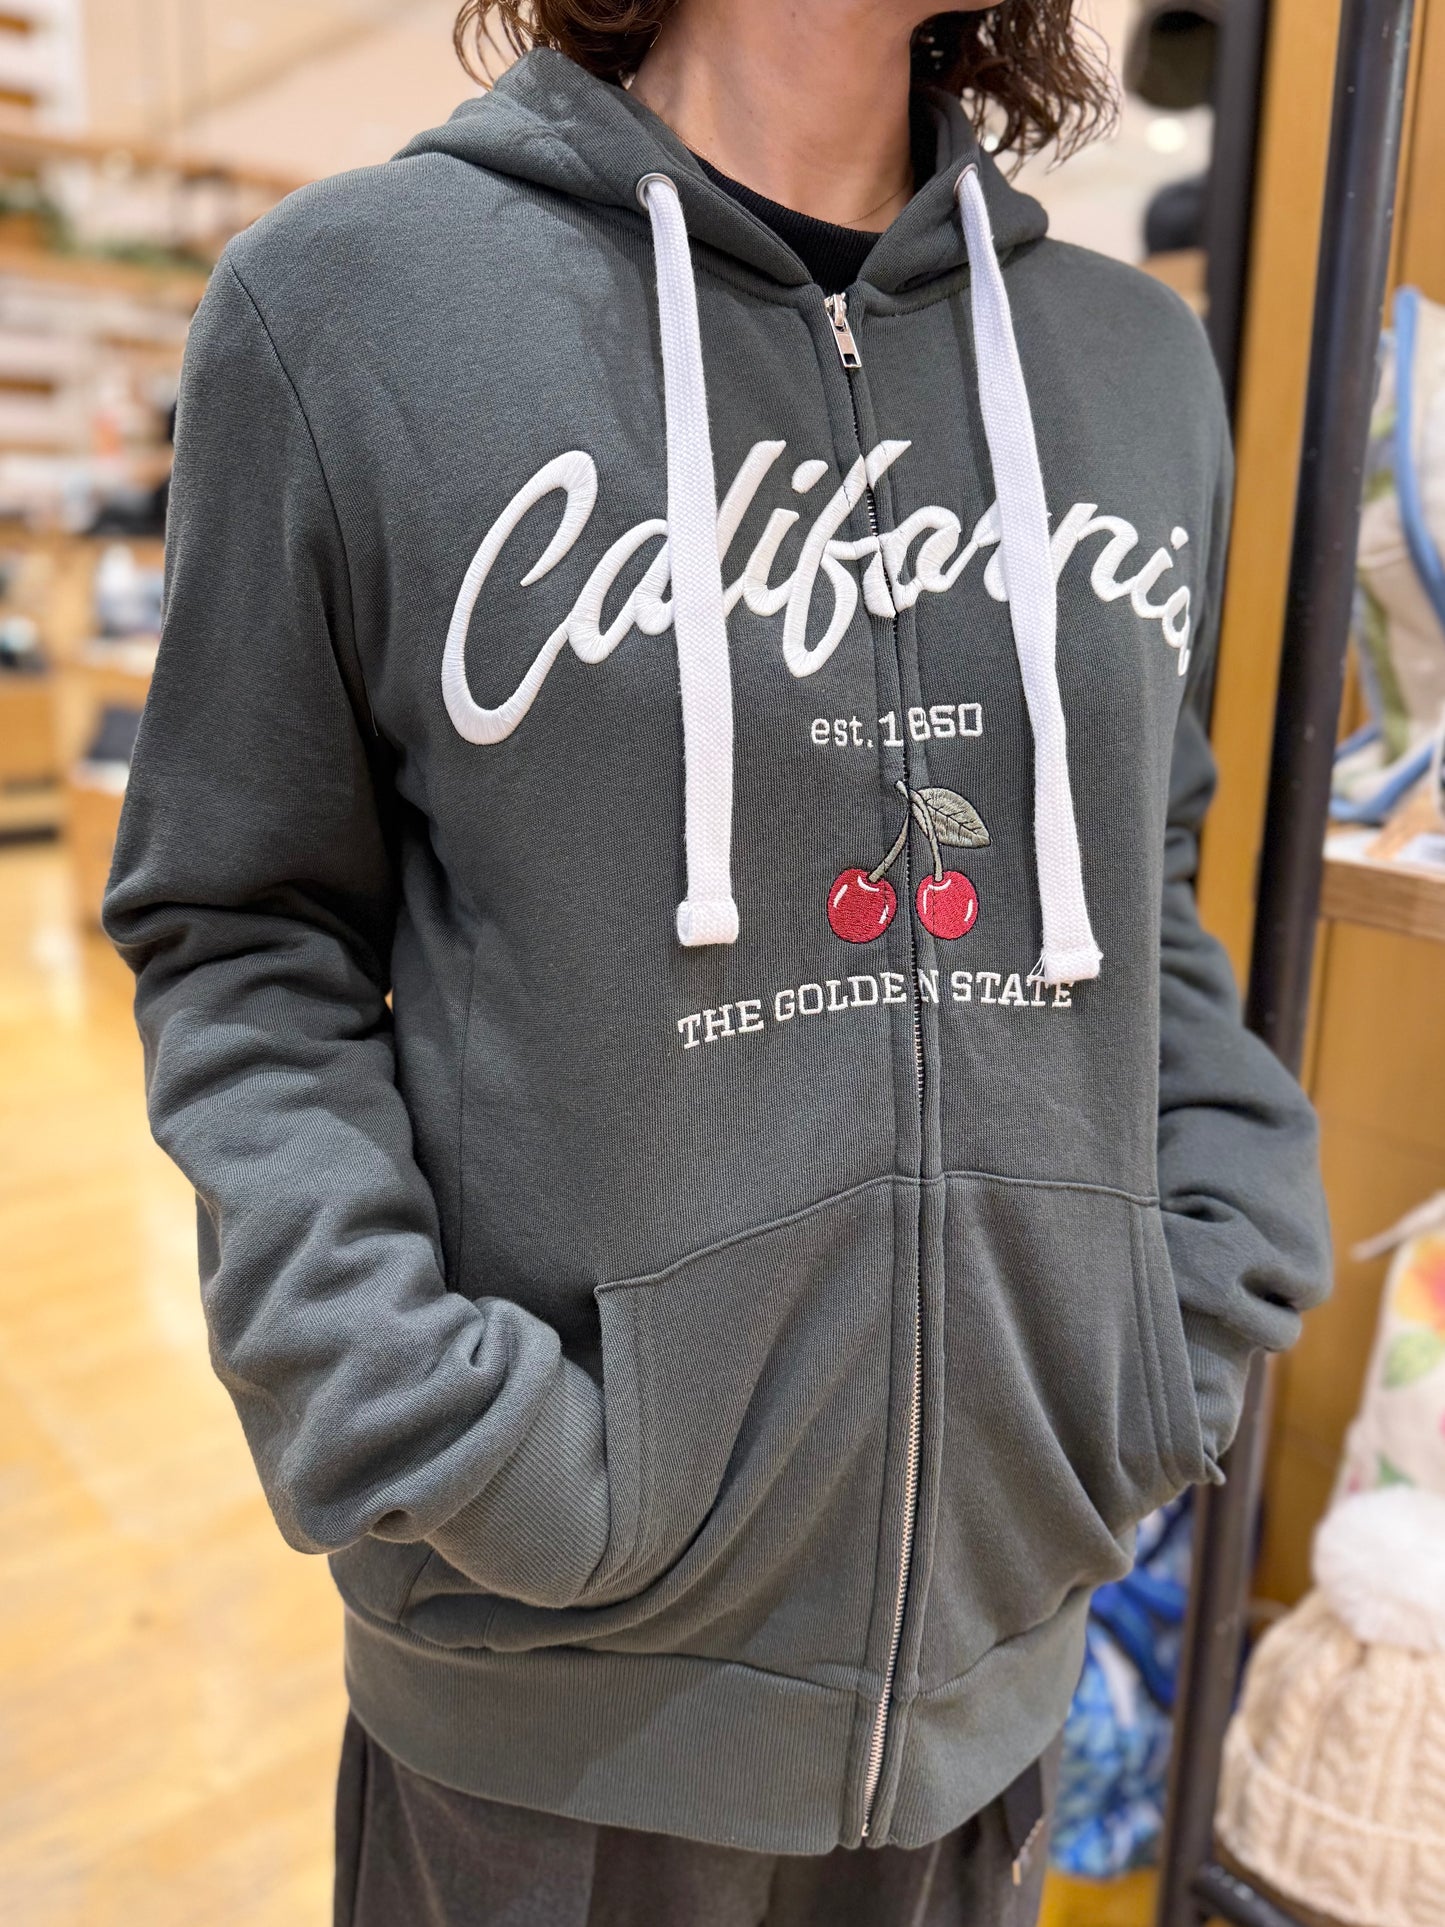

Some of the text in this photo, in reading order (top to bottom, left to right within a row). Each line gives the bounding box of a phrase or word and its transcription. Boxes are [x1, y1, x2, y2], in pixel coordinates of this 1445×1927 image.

[678, 970, 1074, 1049] THE GOLDEN STATE
